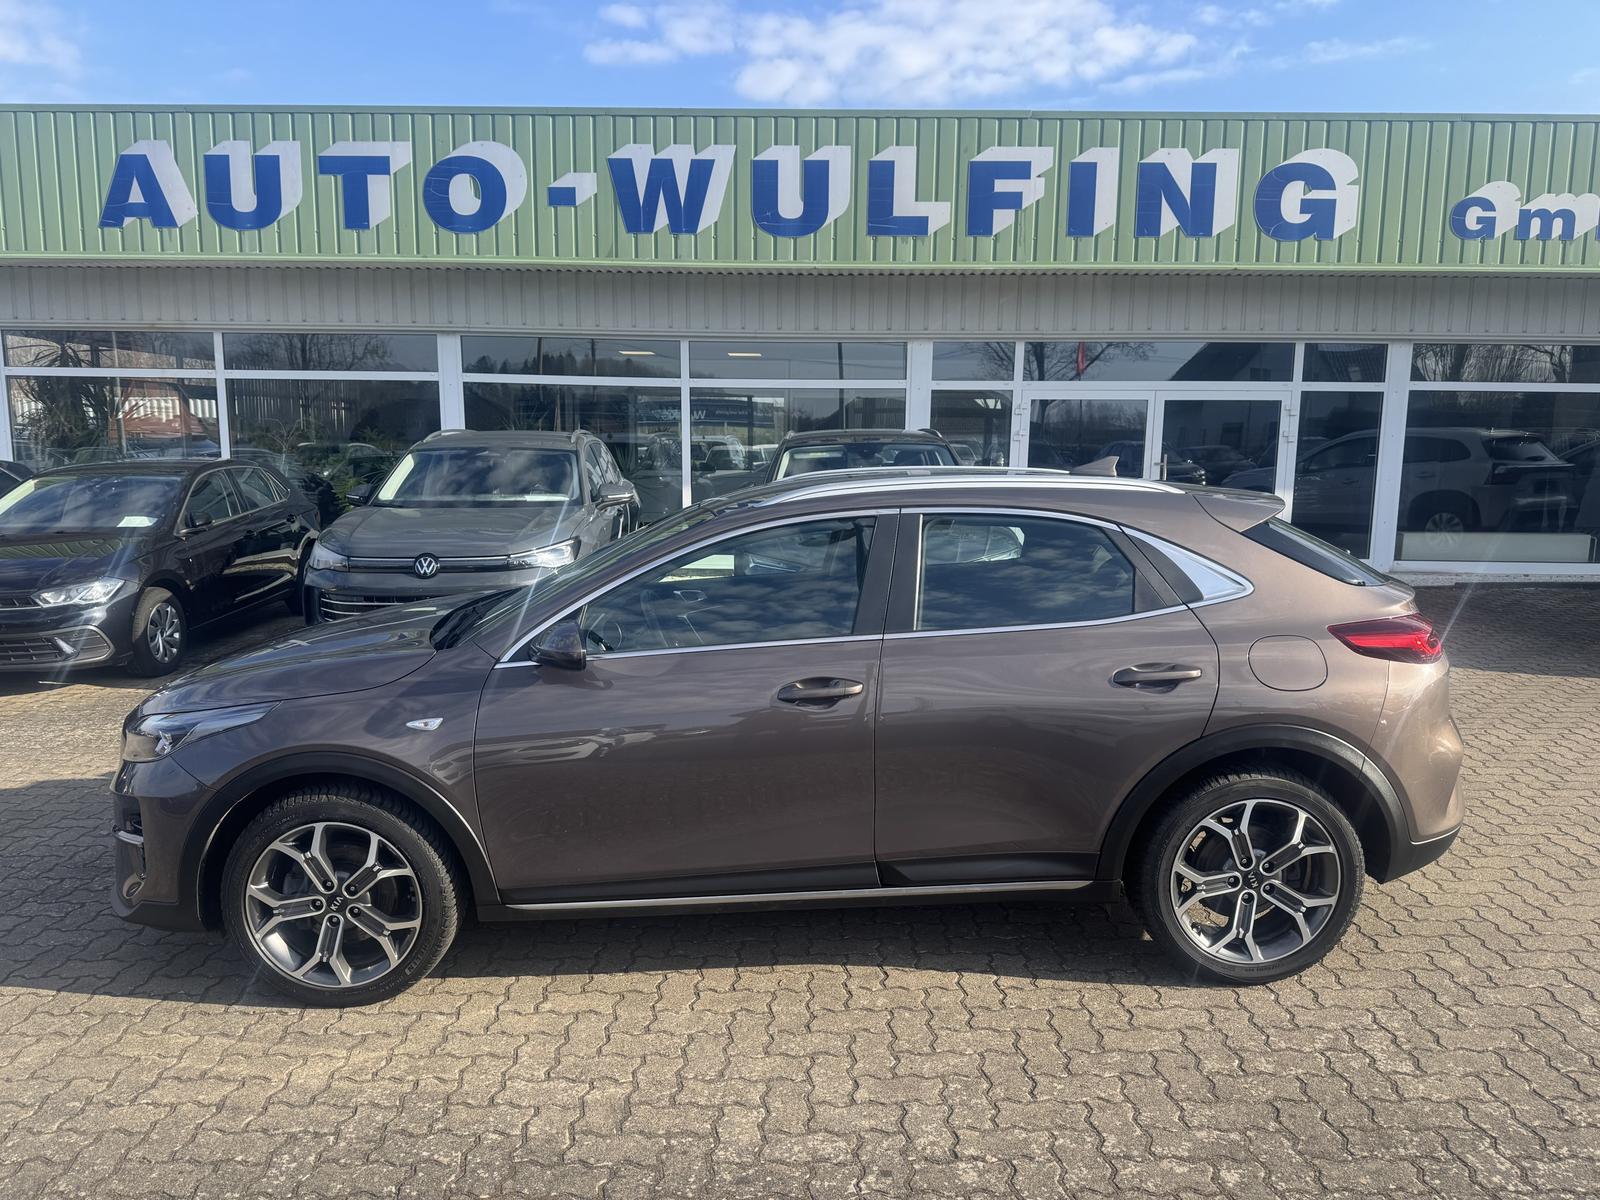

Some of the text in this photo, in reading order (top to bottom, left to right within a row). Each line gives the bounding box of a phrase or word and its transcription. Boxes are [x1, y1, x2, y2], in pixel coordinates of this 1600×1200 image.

[99, 140, 1600, 242] AUTO-WULFING Gm
[330, 896, 344, 912] KIA
